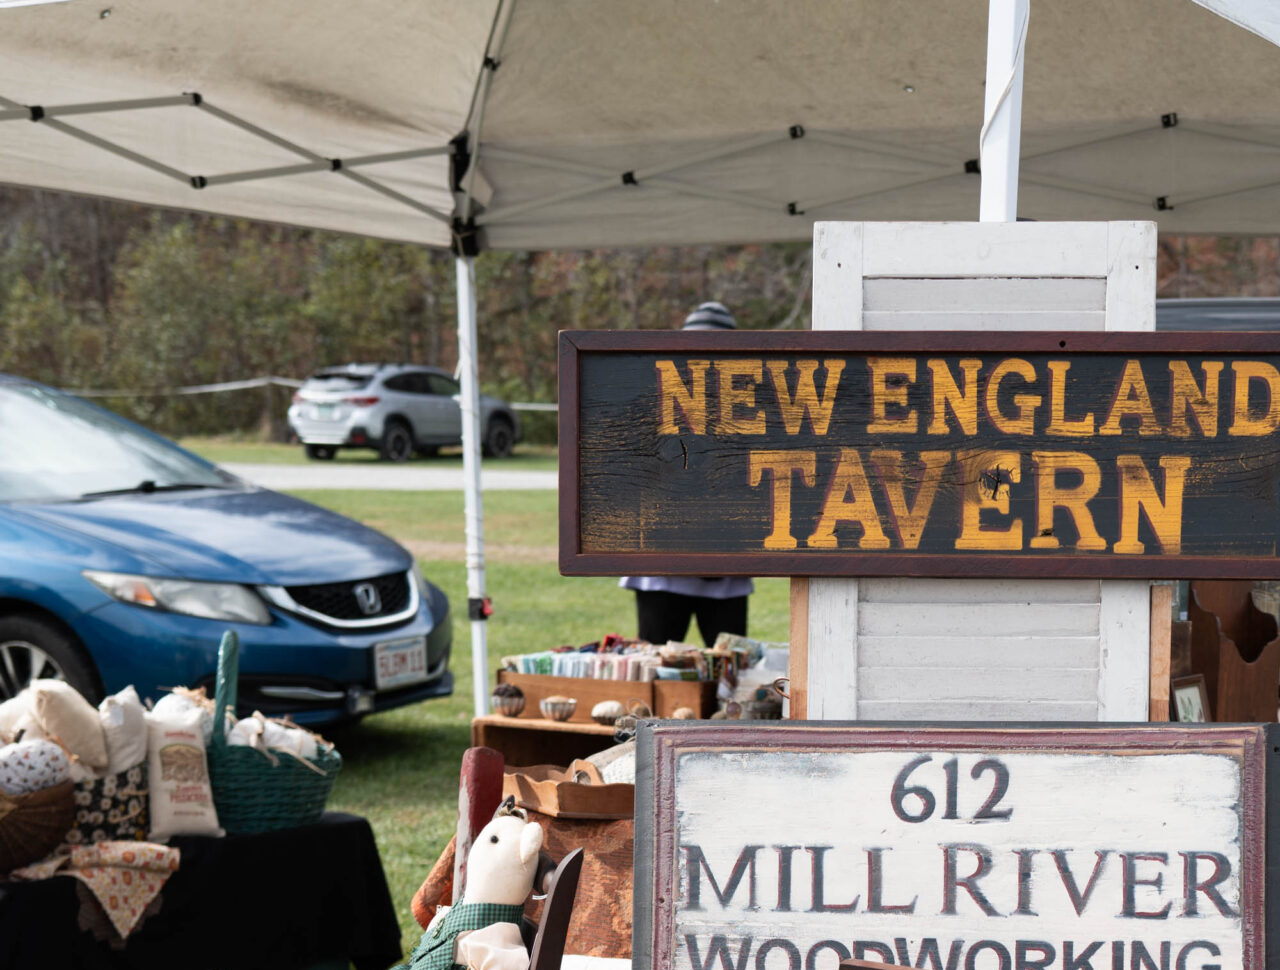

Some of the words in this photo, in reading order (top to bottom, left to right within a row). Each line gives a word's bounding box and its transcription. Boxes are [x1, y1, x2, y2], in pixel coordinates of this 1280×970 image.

[655, 359, 847, 437] NEW
[747, 448, 1192, 554] TAVERN
[890, 755, 1014, 824] 612
[680, 844, 919, 914] MILL
[938, 842, 1240, 919] RIVER
